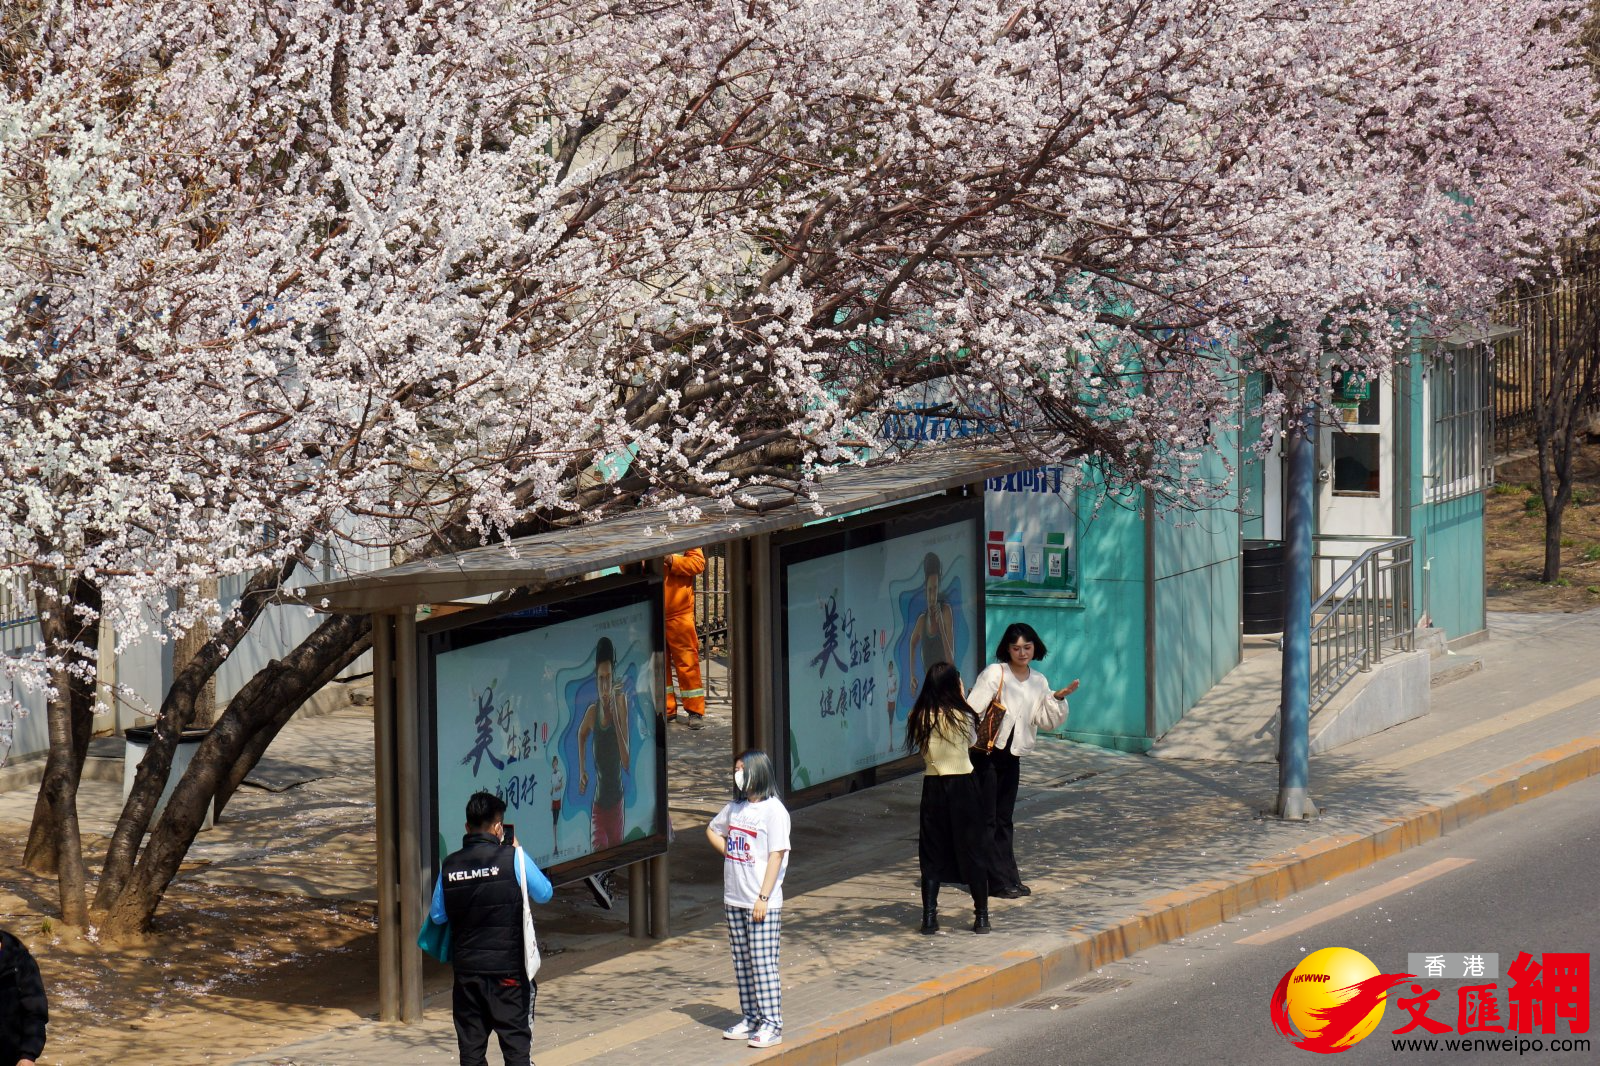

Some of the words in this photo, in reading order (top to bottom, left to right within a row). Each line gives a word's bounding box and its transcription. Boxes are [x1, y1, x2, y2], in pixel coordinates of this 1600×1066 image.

[819, 676, 876, 719] 健康同行
[728, 836, 751, 852] Brillo
[448, 867, 490, 882] KELME
